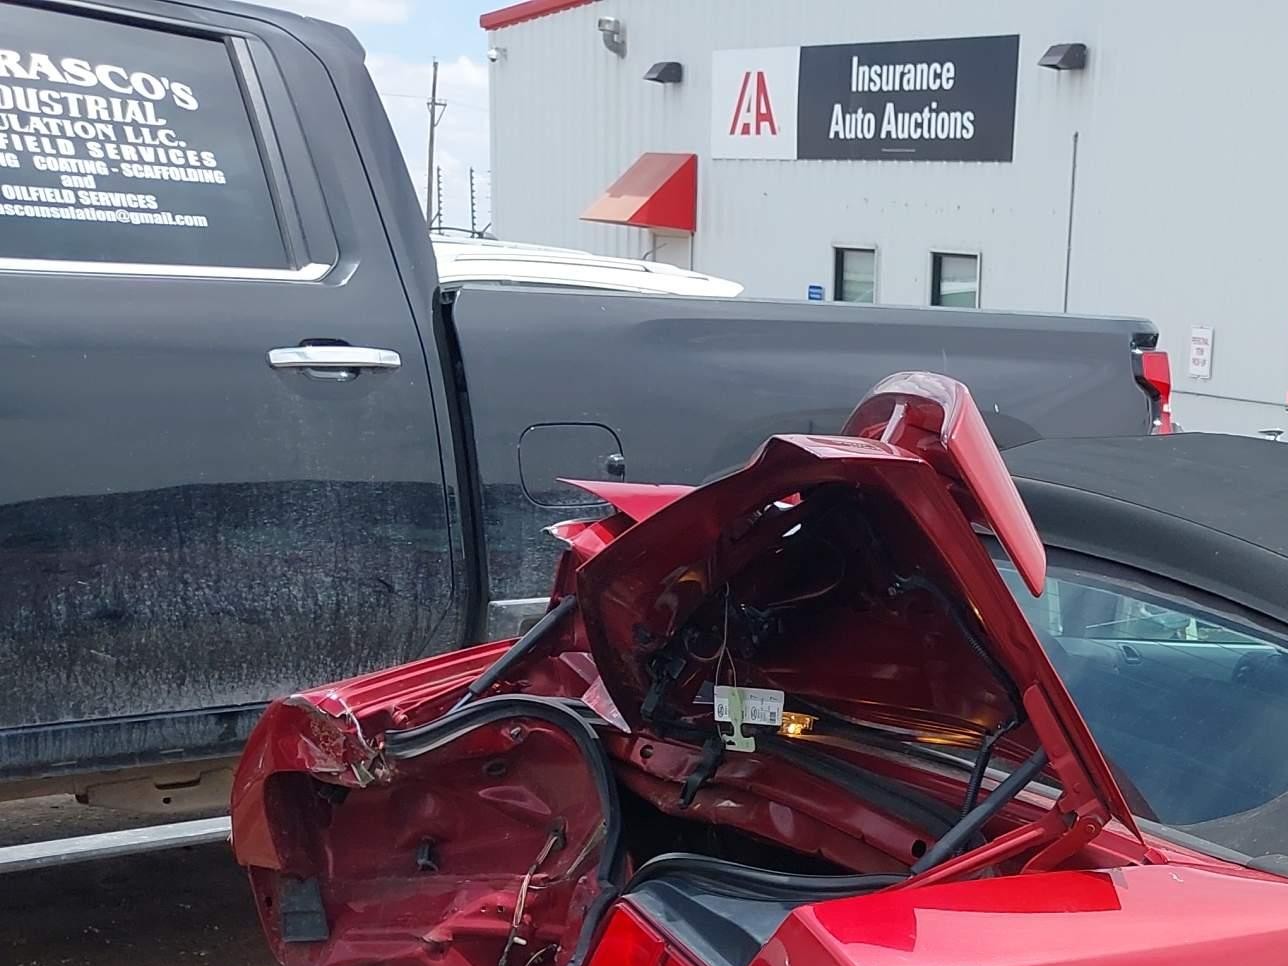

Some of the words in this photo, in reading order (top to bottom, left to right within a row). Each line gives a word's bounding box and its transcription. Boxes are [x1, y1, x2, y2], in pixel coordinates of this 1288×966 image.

[851, 55, 955, 92] Insurance
[829, 103, 876, 139] Auto
[880, 101, 975, 139] Auctions
[123, 125, 187, 148] LLC.
[86, 141, 217, 168] SERVICES
[33, 155, 109, 175] COATING
[120, 162, 227, 184] SCAFFOLDING
[60, 174, 97, 189] and
[2, 184, 76, 204] OILFIELD
[77, 190, 158, 210] SERVICES
